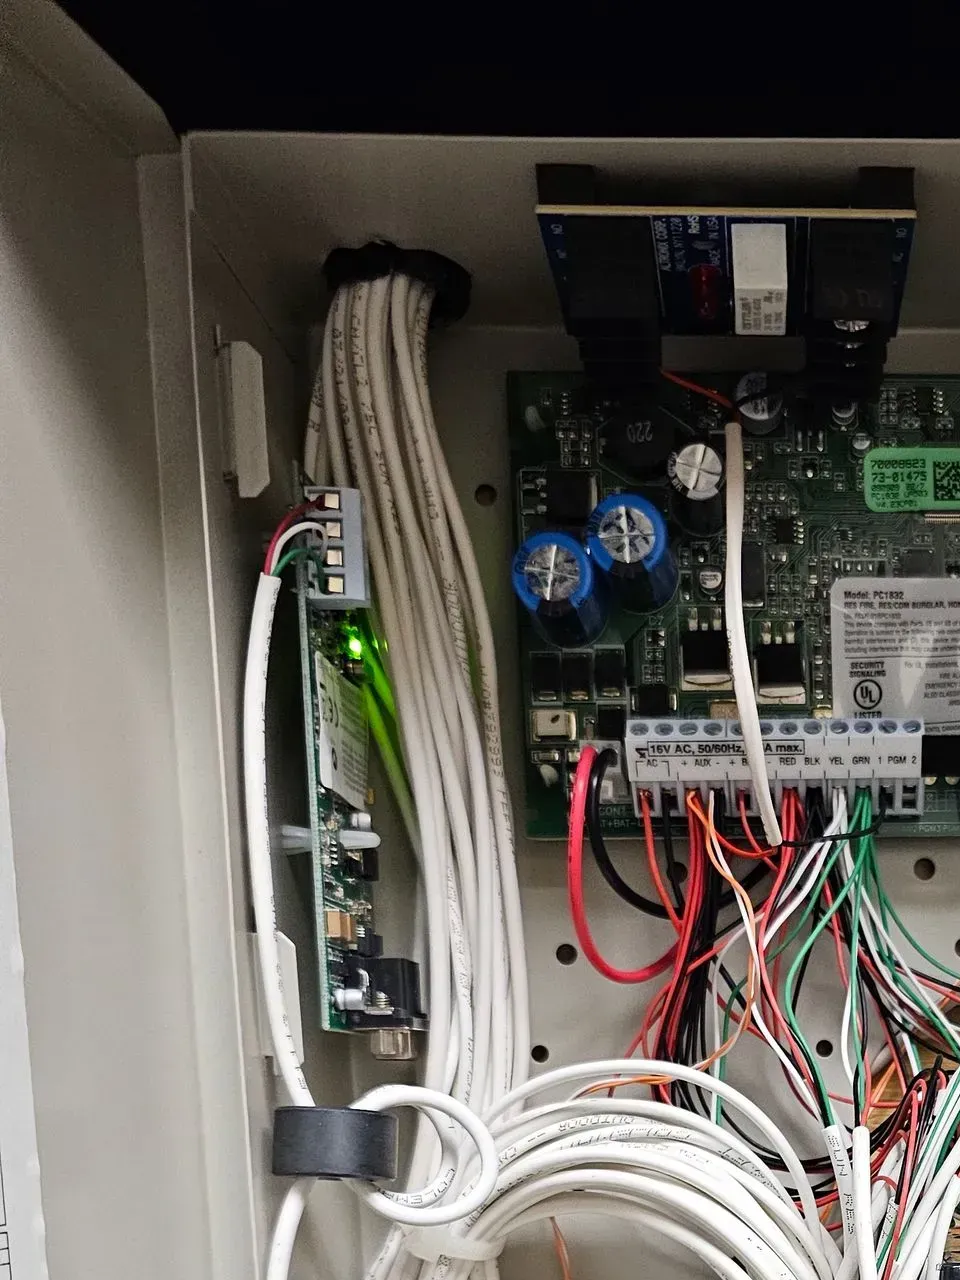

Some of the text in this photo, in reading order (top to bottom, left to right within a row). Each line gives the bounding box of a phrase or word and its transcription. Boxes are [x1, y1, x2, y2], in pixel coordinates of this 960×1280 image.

[850, 661, 884, 670] SECURITY
[849, 670, 886, 678] SIGNALING
[650, 744, 671, 754] 16V
[675, 744, 695, 756] AC,
[698, 743, 745, 756] 50/60Hz,
[776, 743, 803, 753] max.
[646, 759, 658, 767] AC
[694, 759, 712, 767] AUX
[780, 757, 797, 766] RED
[804, 757, 821, 766] BLK
[829, 757, 844, 766] YEL
[852, 756, 870, 766] GRN
[888, 756, 907, 765] PGM
[911, 756, 917, 765] 2
